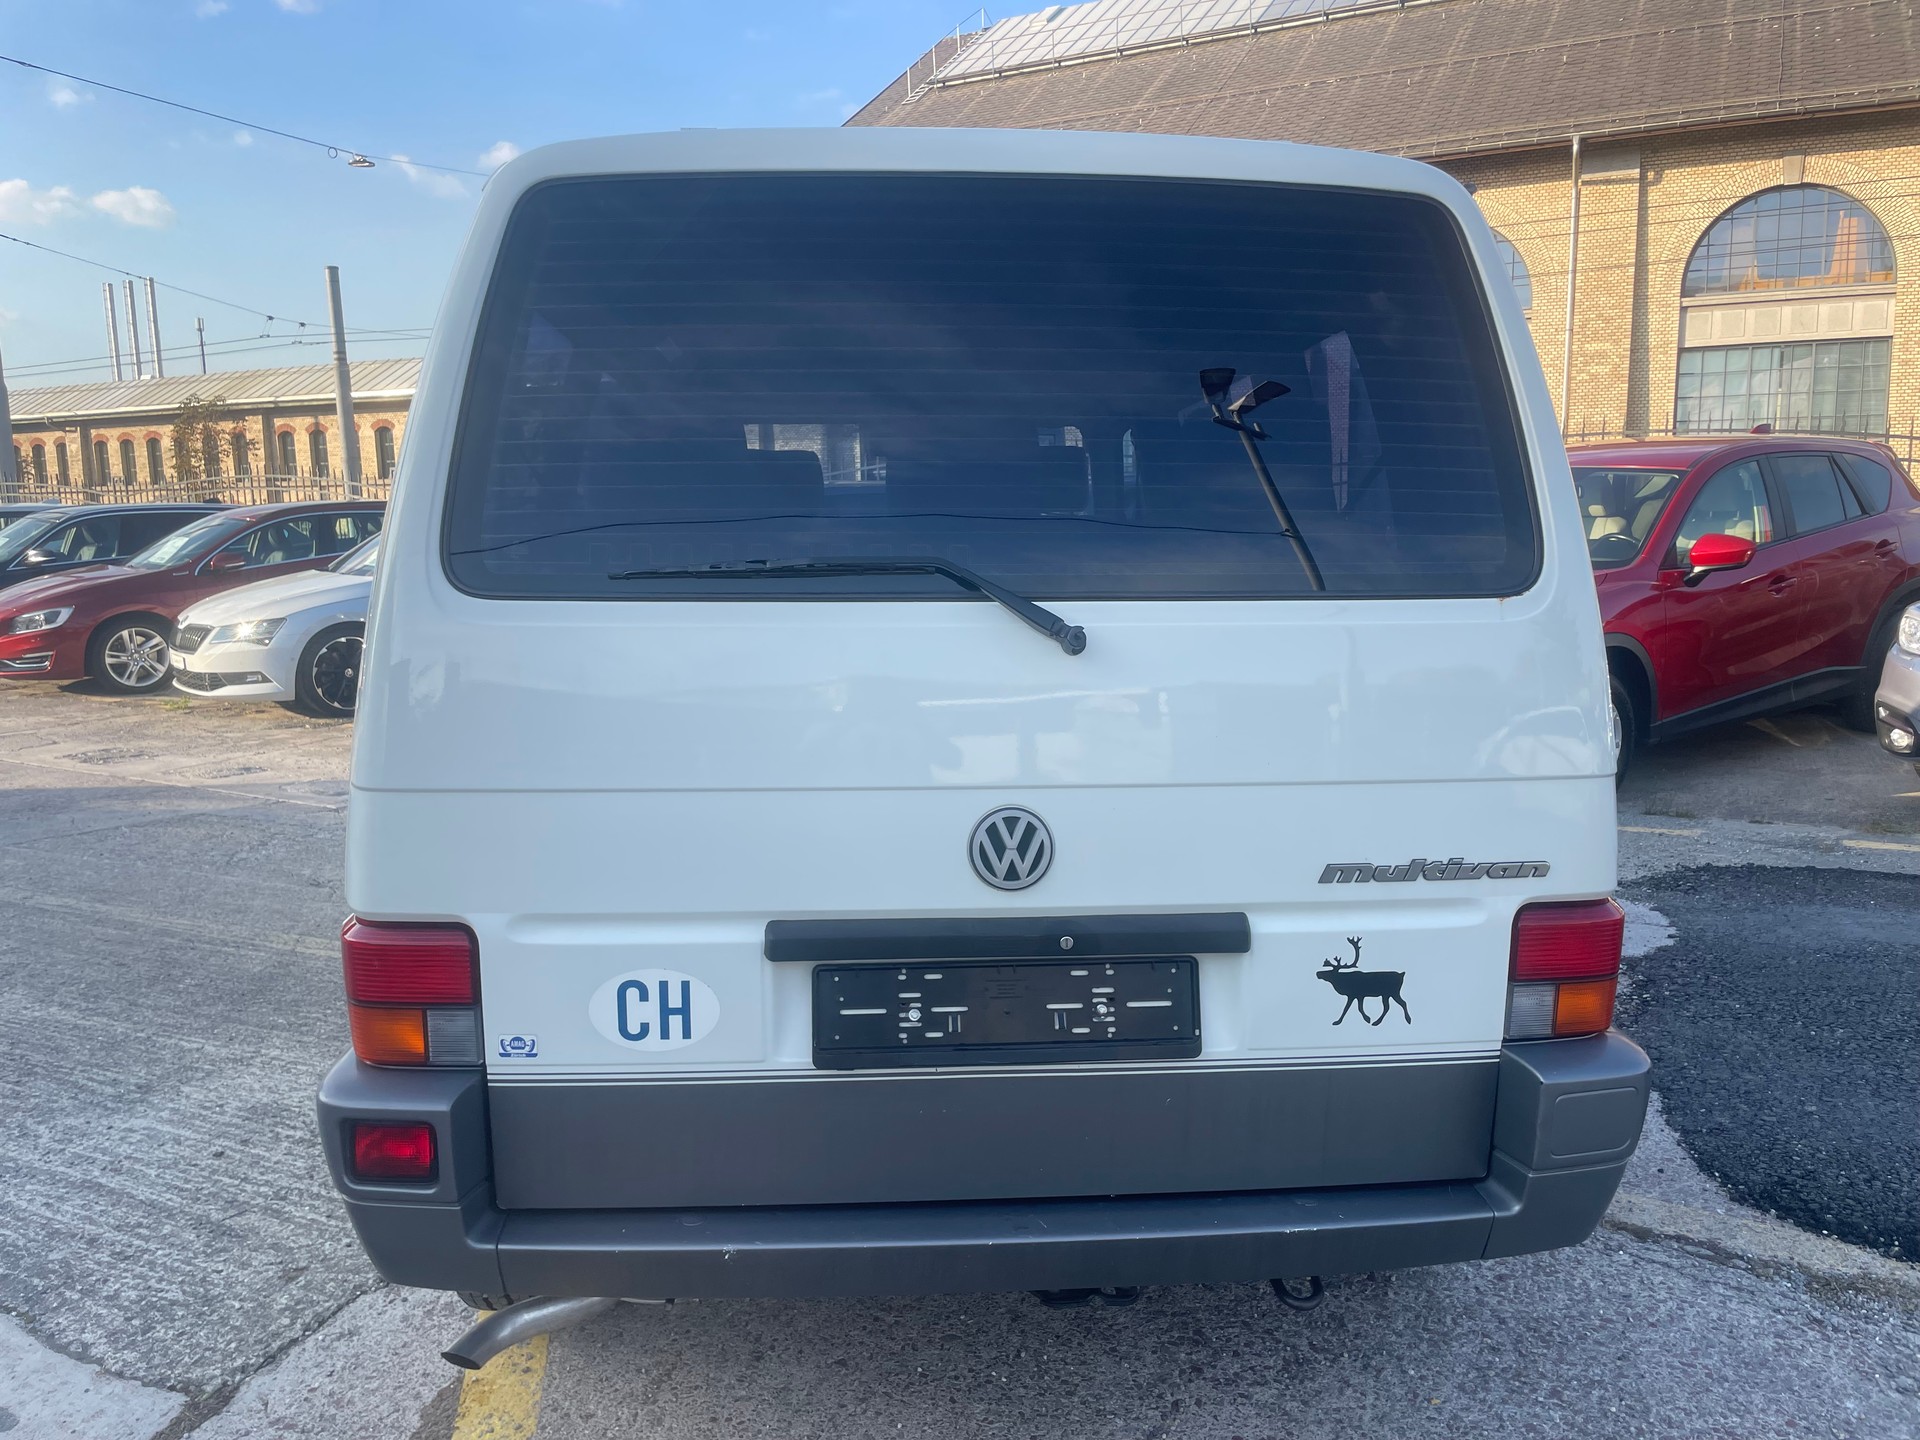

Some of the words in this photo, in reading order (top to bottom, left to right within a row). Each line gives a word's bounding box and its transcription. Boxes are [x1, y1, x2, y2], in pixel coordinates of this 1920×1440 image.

[971, 808, 1052, 889] VW
[1317, 857, 1551, 884] multivan
[616, 979, 692, 1042] CH
[511, 1040, 525, 1048] AMAG
